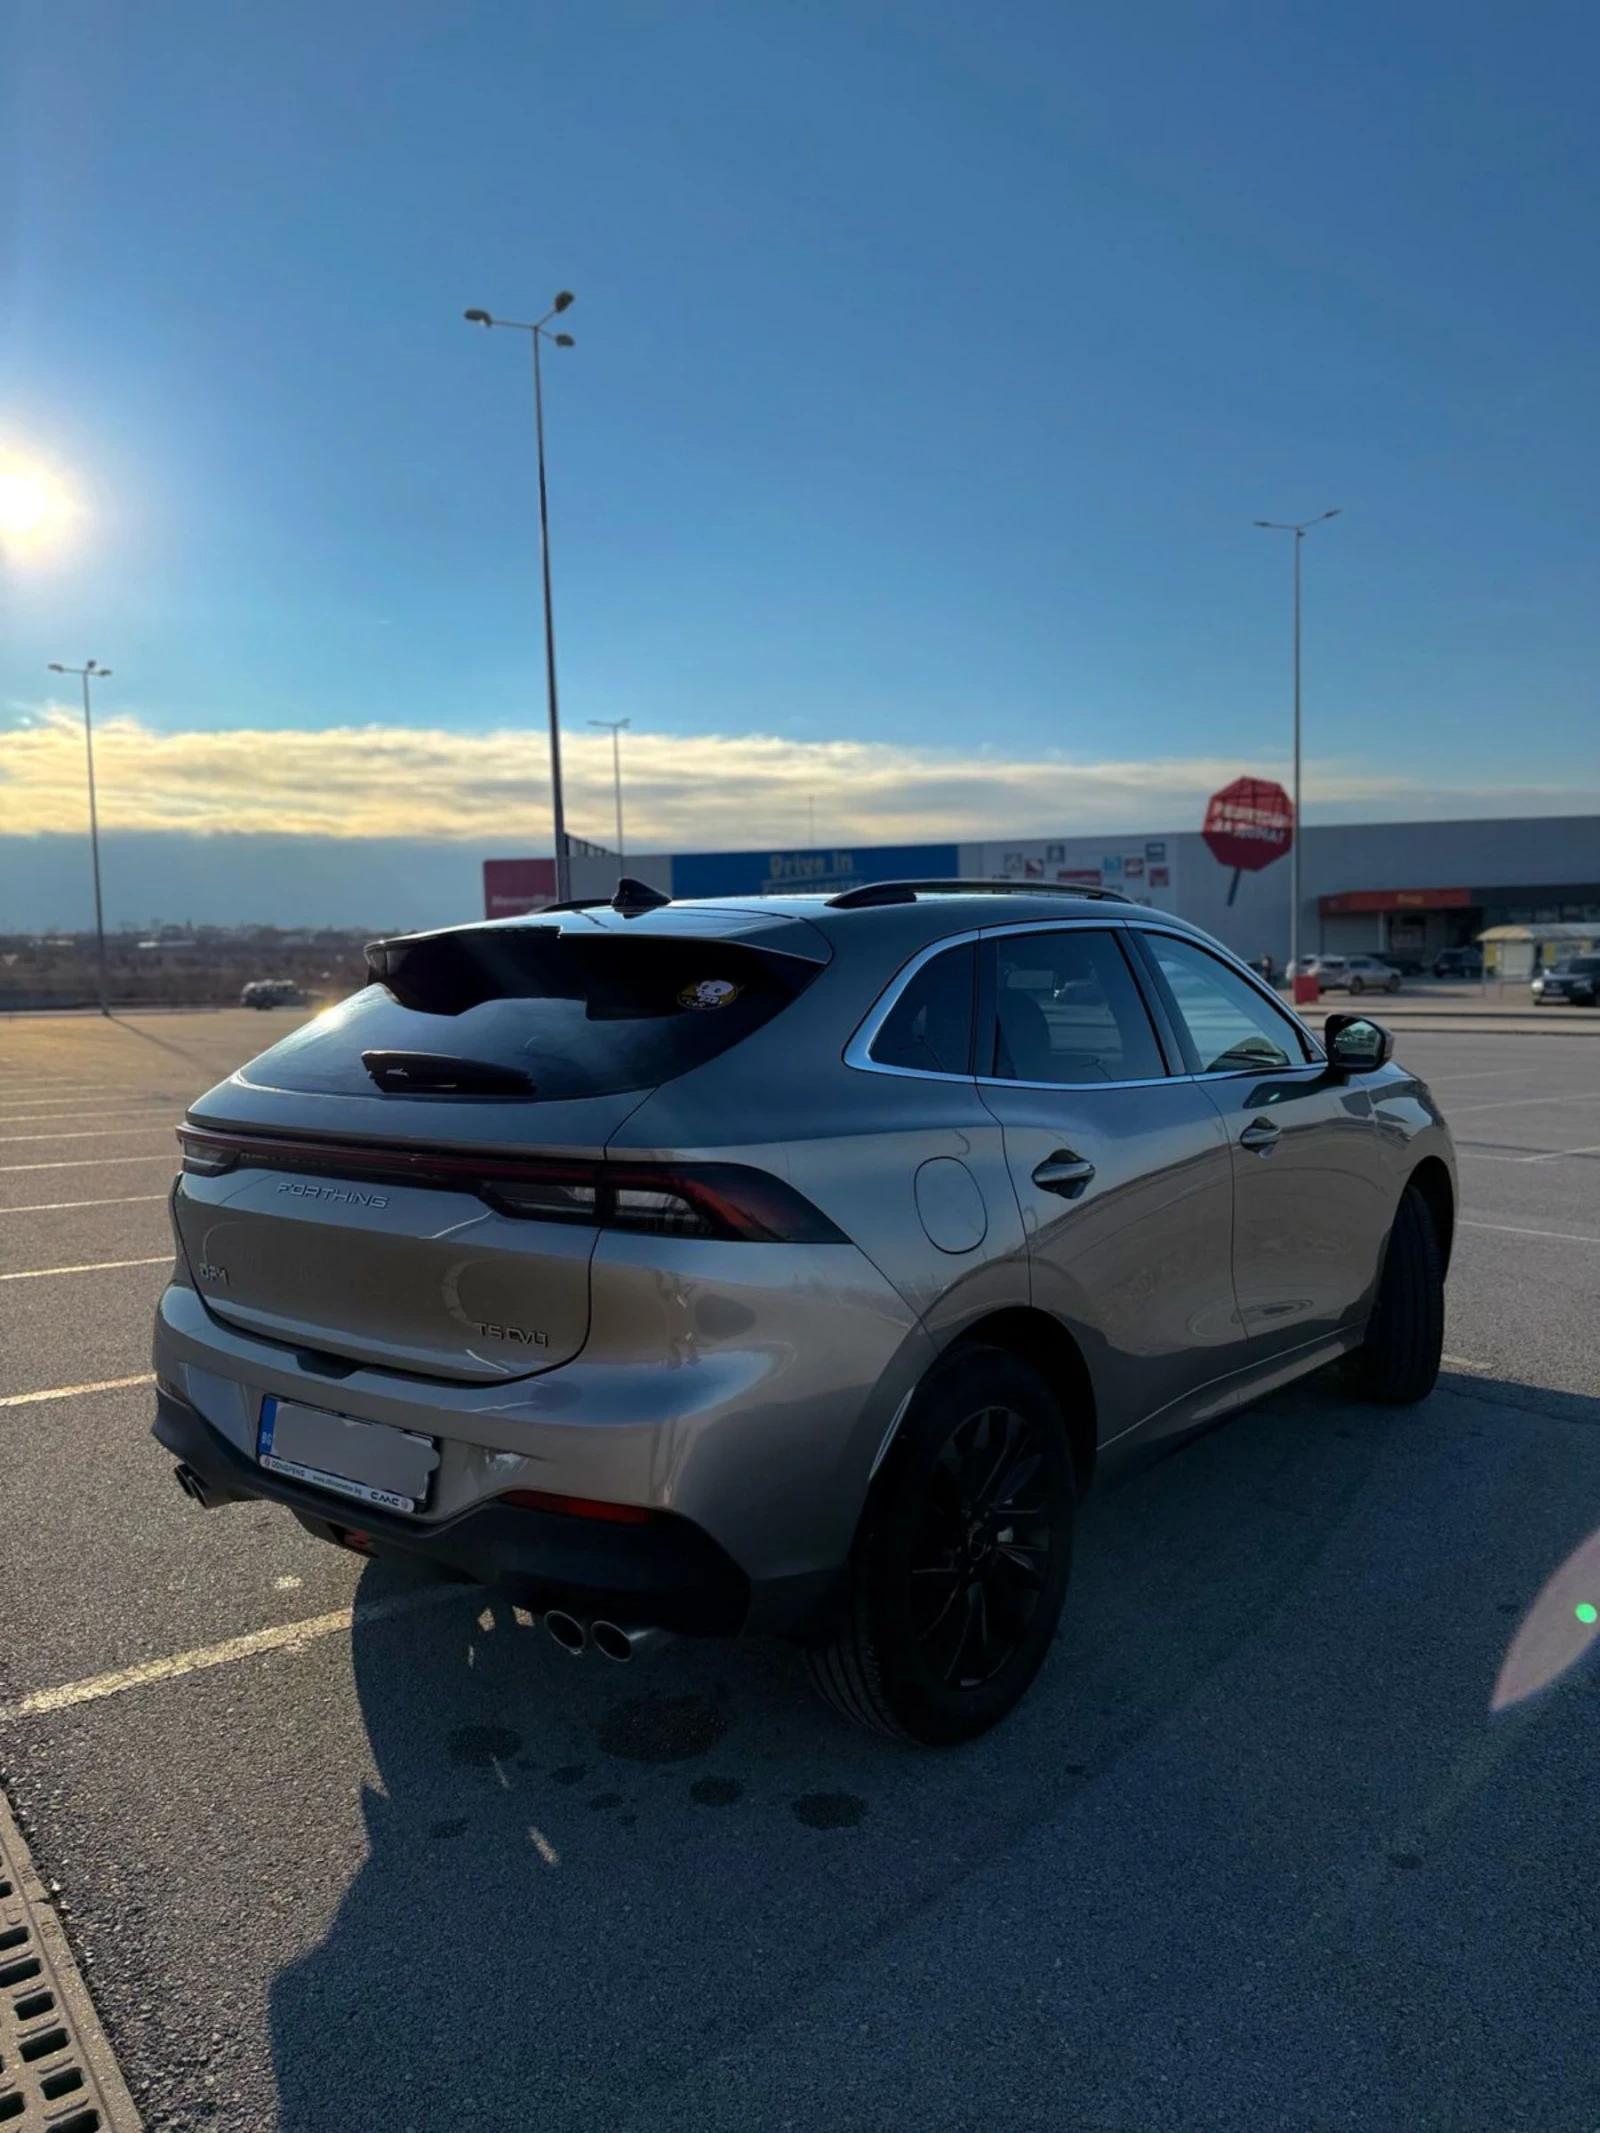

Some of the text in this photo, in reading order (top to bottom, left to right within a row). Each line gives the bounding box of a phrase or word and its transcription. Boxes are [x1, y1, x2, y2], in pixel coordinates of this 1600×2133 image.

[277, 1182, 389, 1208] FORTHING
[272, 1458, 305, 1478] DONGFENG
[370, 1491, 400, 1507] CMC
